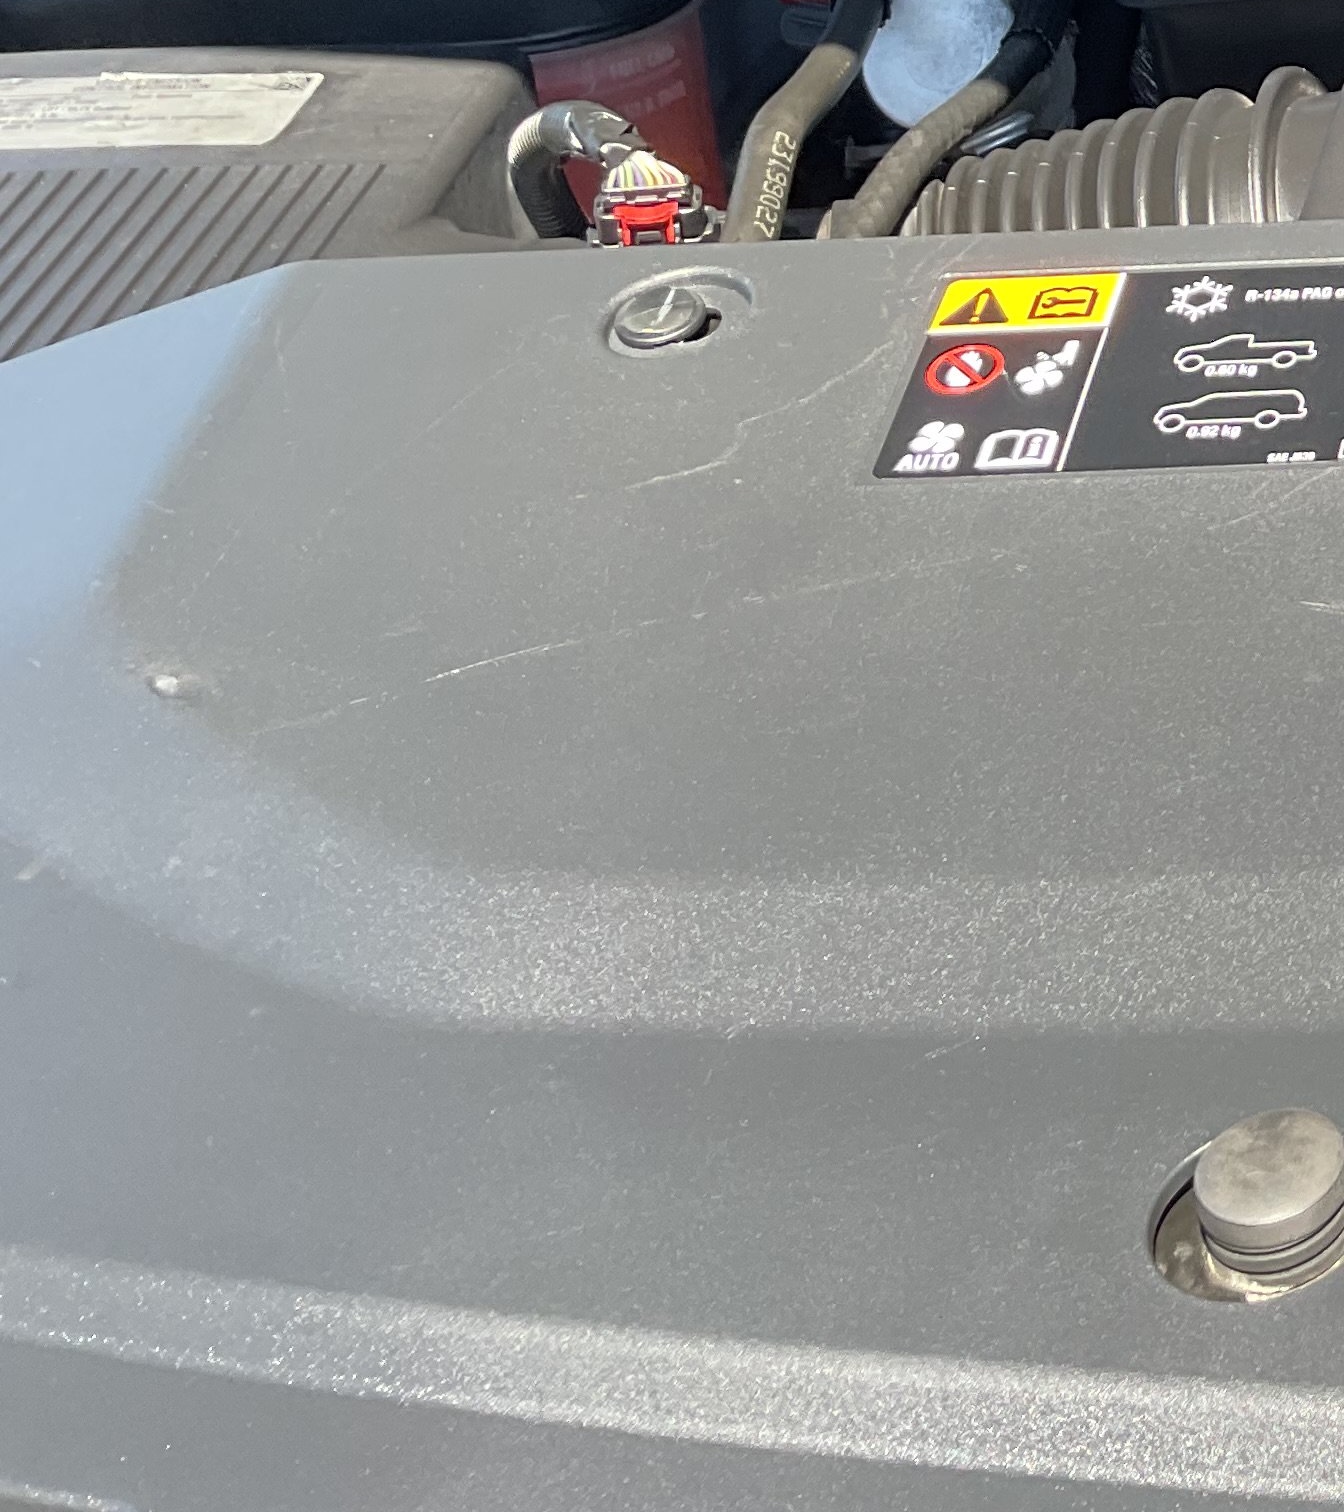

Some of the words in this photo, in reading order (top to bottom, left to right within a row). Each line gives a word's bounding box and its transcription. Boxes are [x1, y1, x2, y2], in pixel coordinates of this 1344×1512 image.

[753, 130, 797, 240] 23199027
[1245, 288, 1299, 303] R-134a
[1301, 287, 1333, 300] PAG
[1238, 363, 1258, 378] kg
[1221, 424, 1241, 439] kg
[892, 452, 960, 472] AUTO
